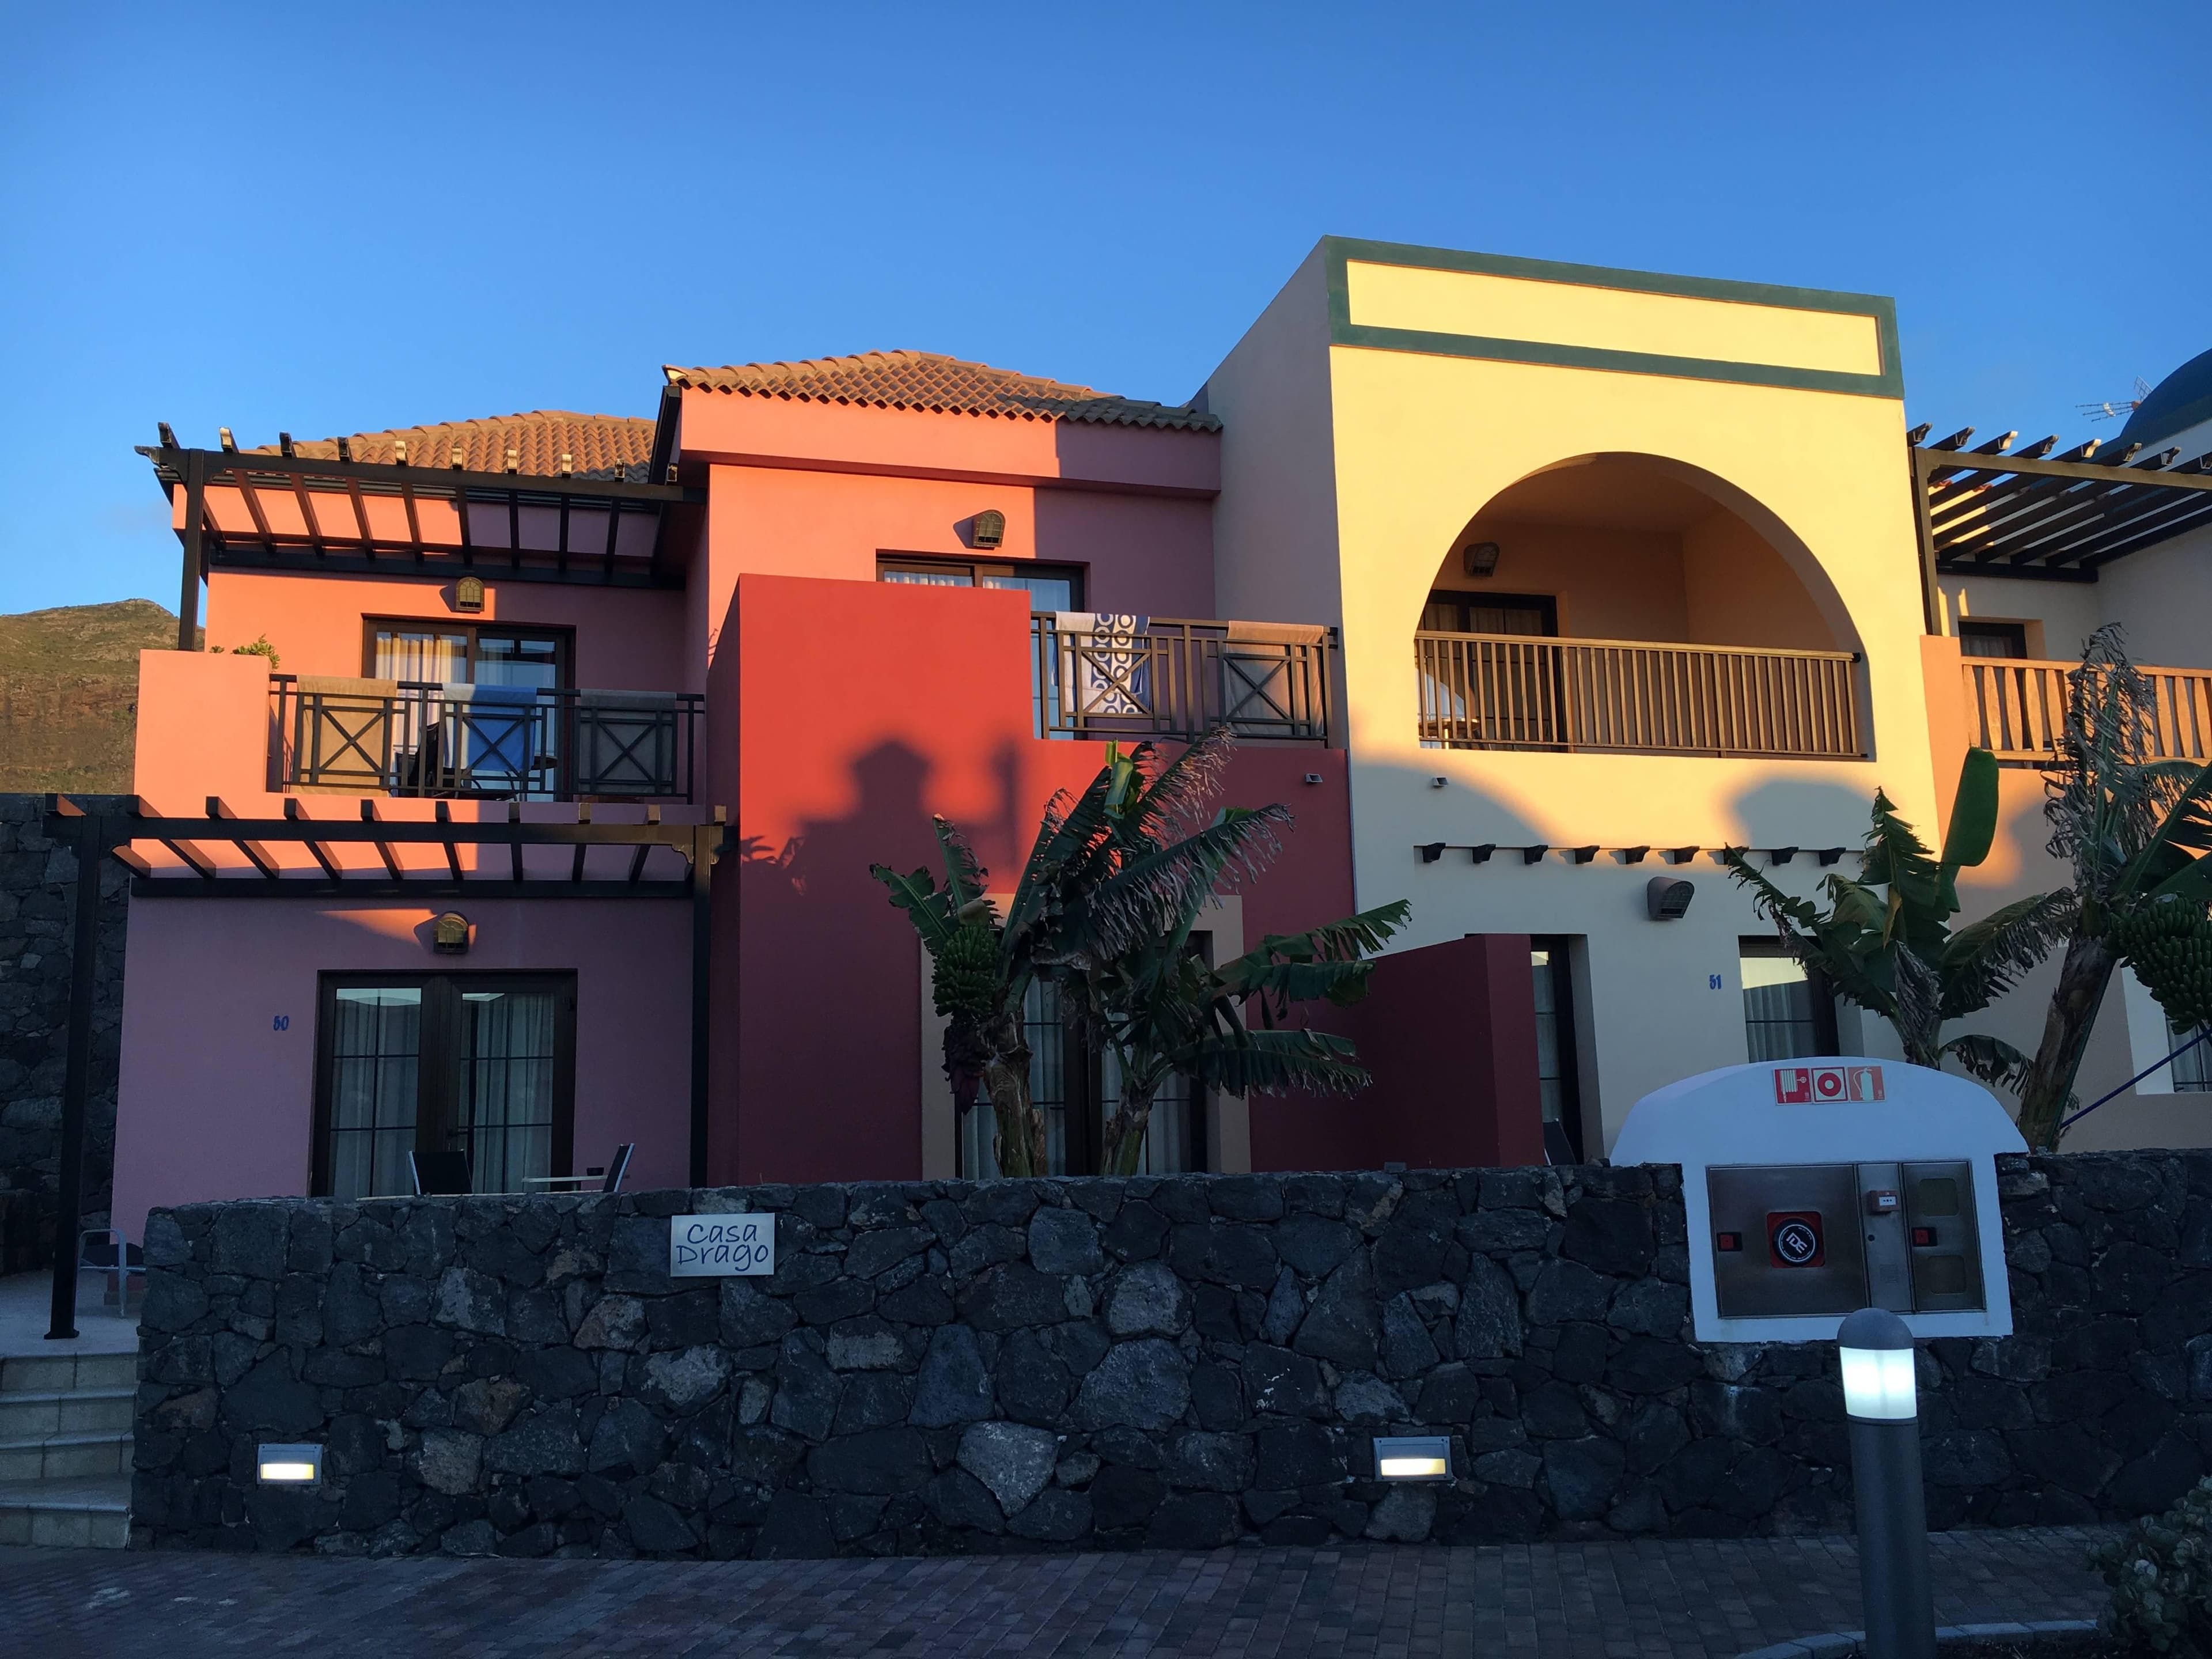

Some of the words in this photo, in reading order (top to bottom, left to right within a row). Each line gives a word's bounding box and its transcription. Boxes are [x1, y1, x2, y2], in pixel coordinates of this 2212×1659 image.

[1709, 974, 1722, 990] 51
[273, 1015, 289, 1031] 50
[676, 1244, 769, 1272] Drago
